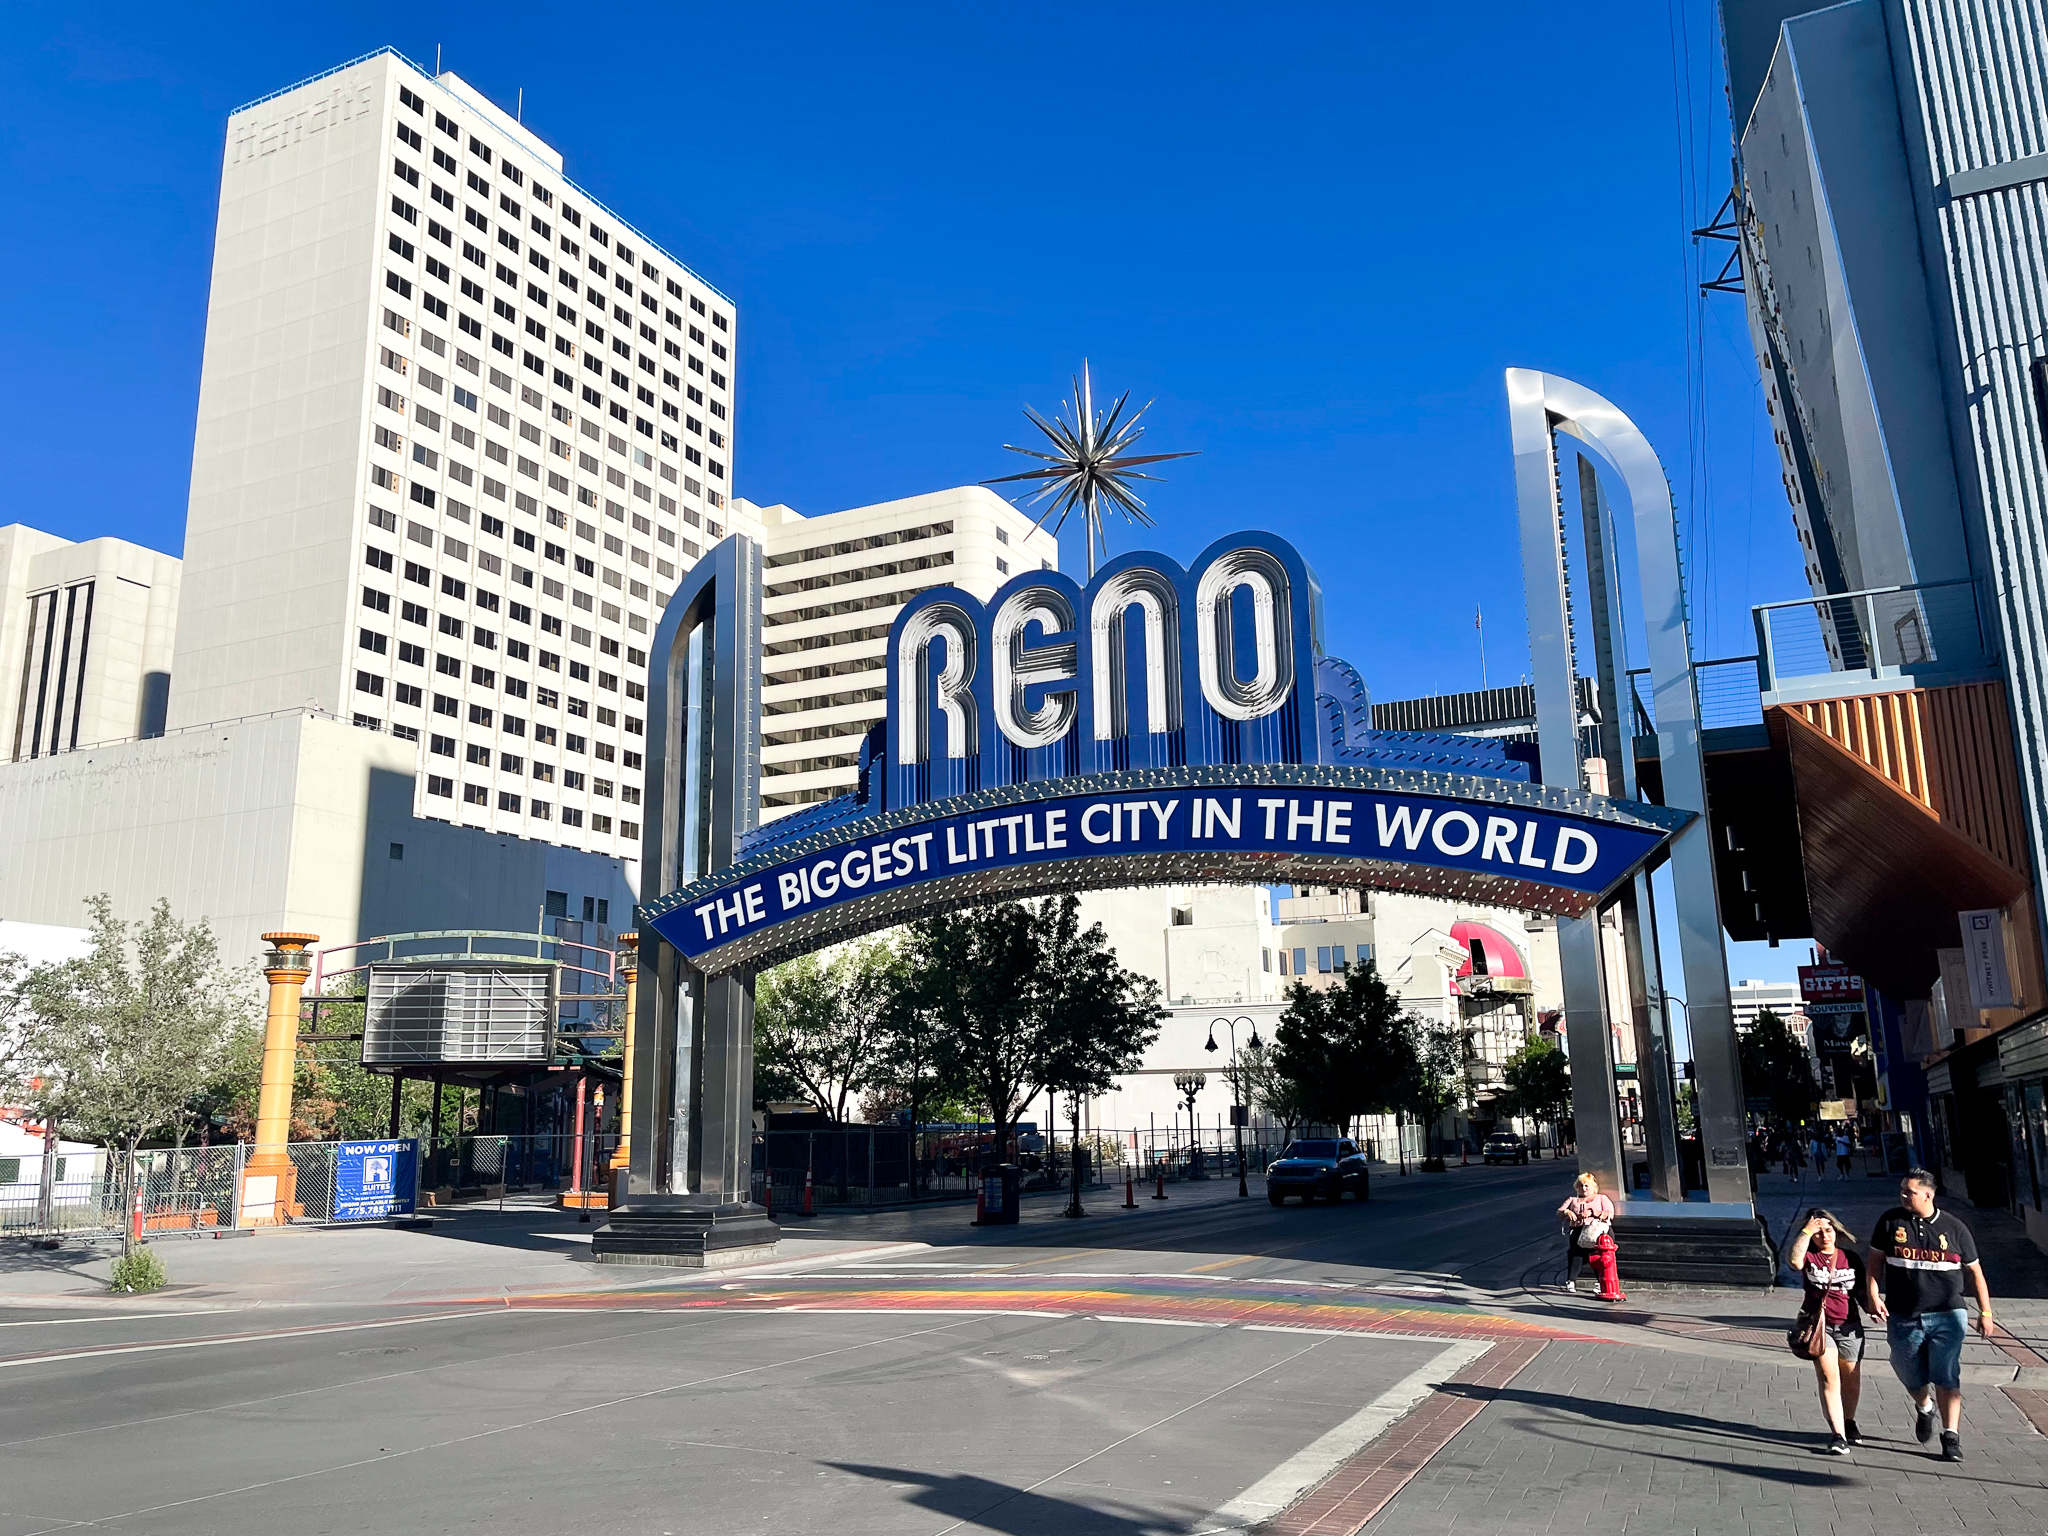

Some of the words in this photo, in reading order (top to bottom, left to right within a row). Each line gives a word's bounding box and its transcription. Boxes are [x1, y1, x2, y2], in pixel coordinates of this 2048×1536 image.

[898, 547, 1295, 765] RENO
[694, 883, 766, 941] THE
[778, 832, 934, 911] BIGGEST
[947, 809, 1067, 865] LITTLE
[1080, 799, 1180, 844] CITY
[1192, 798, 1241, 839] IN
[1258, 798, 1353, 844] THE
[1375, 803, 1599, 875] WORLD
[1803, 975, 1862, 992] GIFTS
[1808, 1003, 1863, 1013] SOUVENIRS
[345, 1144, 376, 1156] NOW
[378, 1142, 411, 1154] OPEN
[362, 1183, 391, 1192] SUITES
[348, 1204, 402, 1216] 775.785.1111
